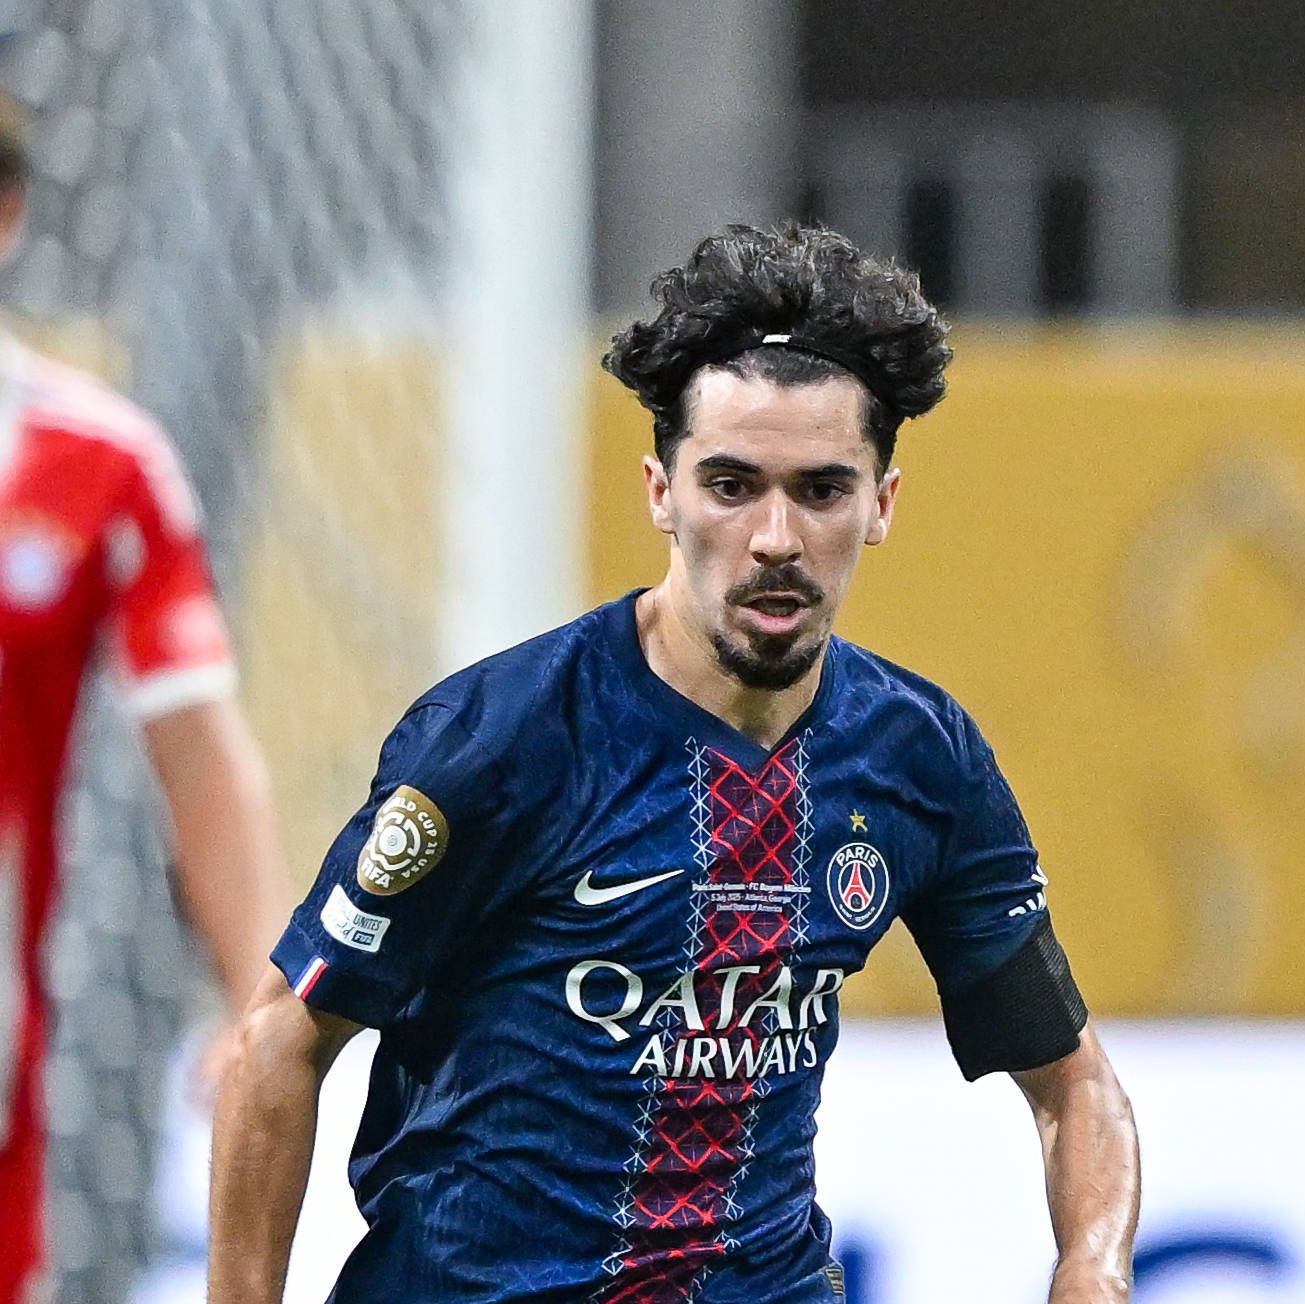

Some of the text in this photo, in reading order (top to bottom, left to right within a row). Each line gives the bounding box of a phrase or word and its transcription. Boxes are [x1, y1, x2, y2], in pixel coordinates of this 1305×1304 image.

[417, 811, 437, 837] CUP
[401, 858, 427, 878] USA
[836, 847, 878, 868] PARIS
[565, 960, 844, 1042] QATAR
[630, 1026, 818, 1080] AIRWAYS
